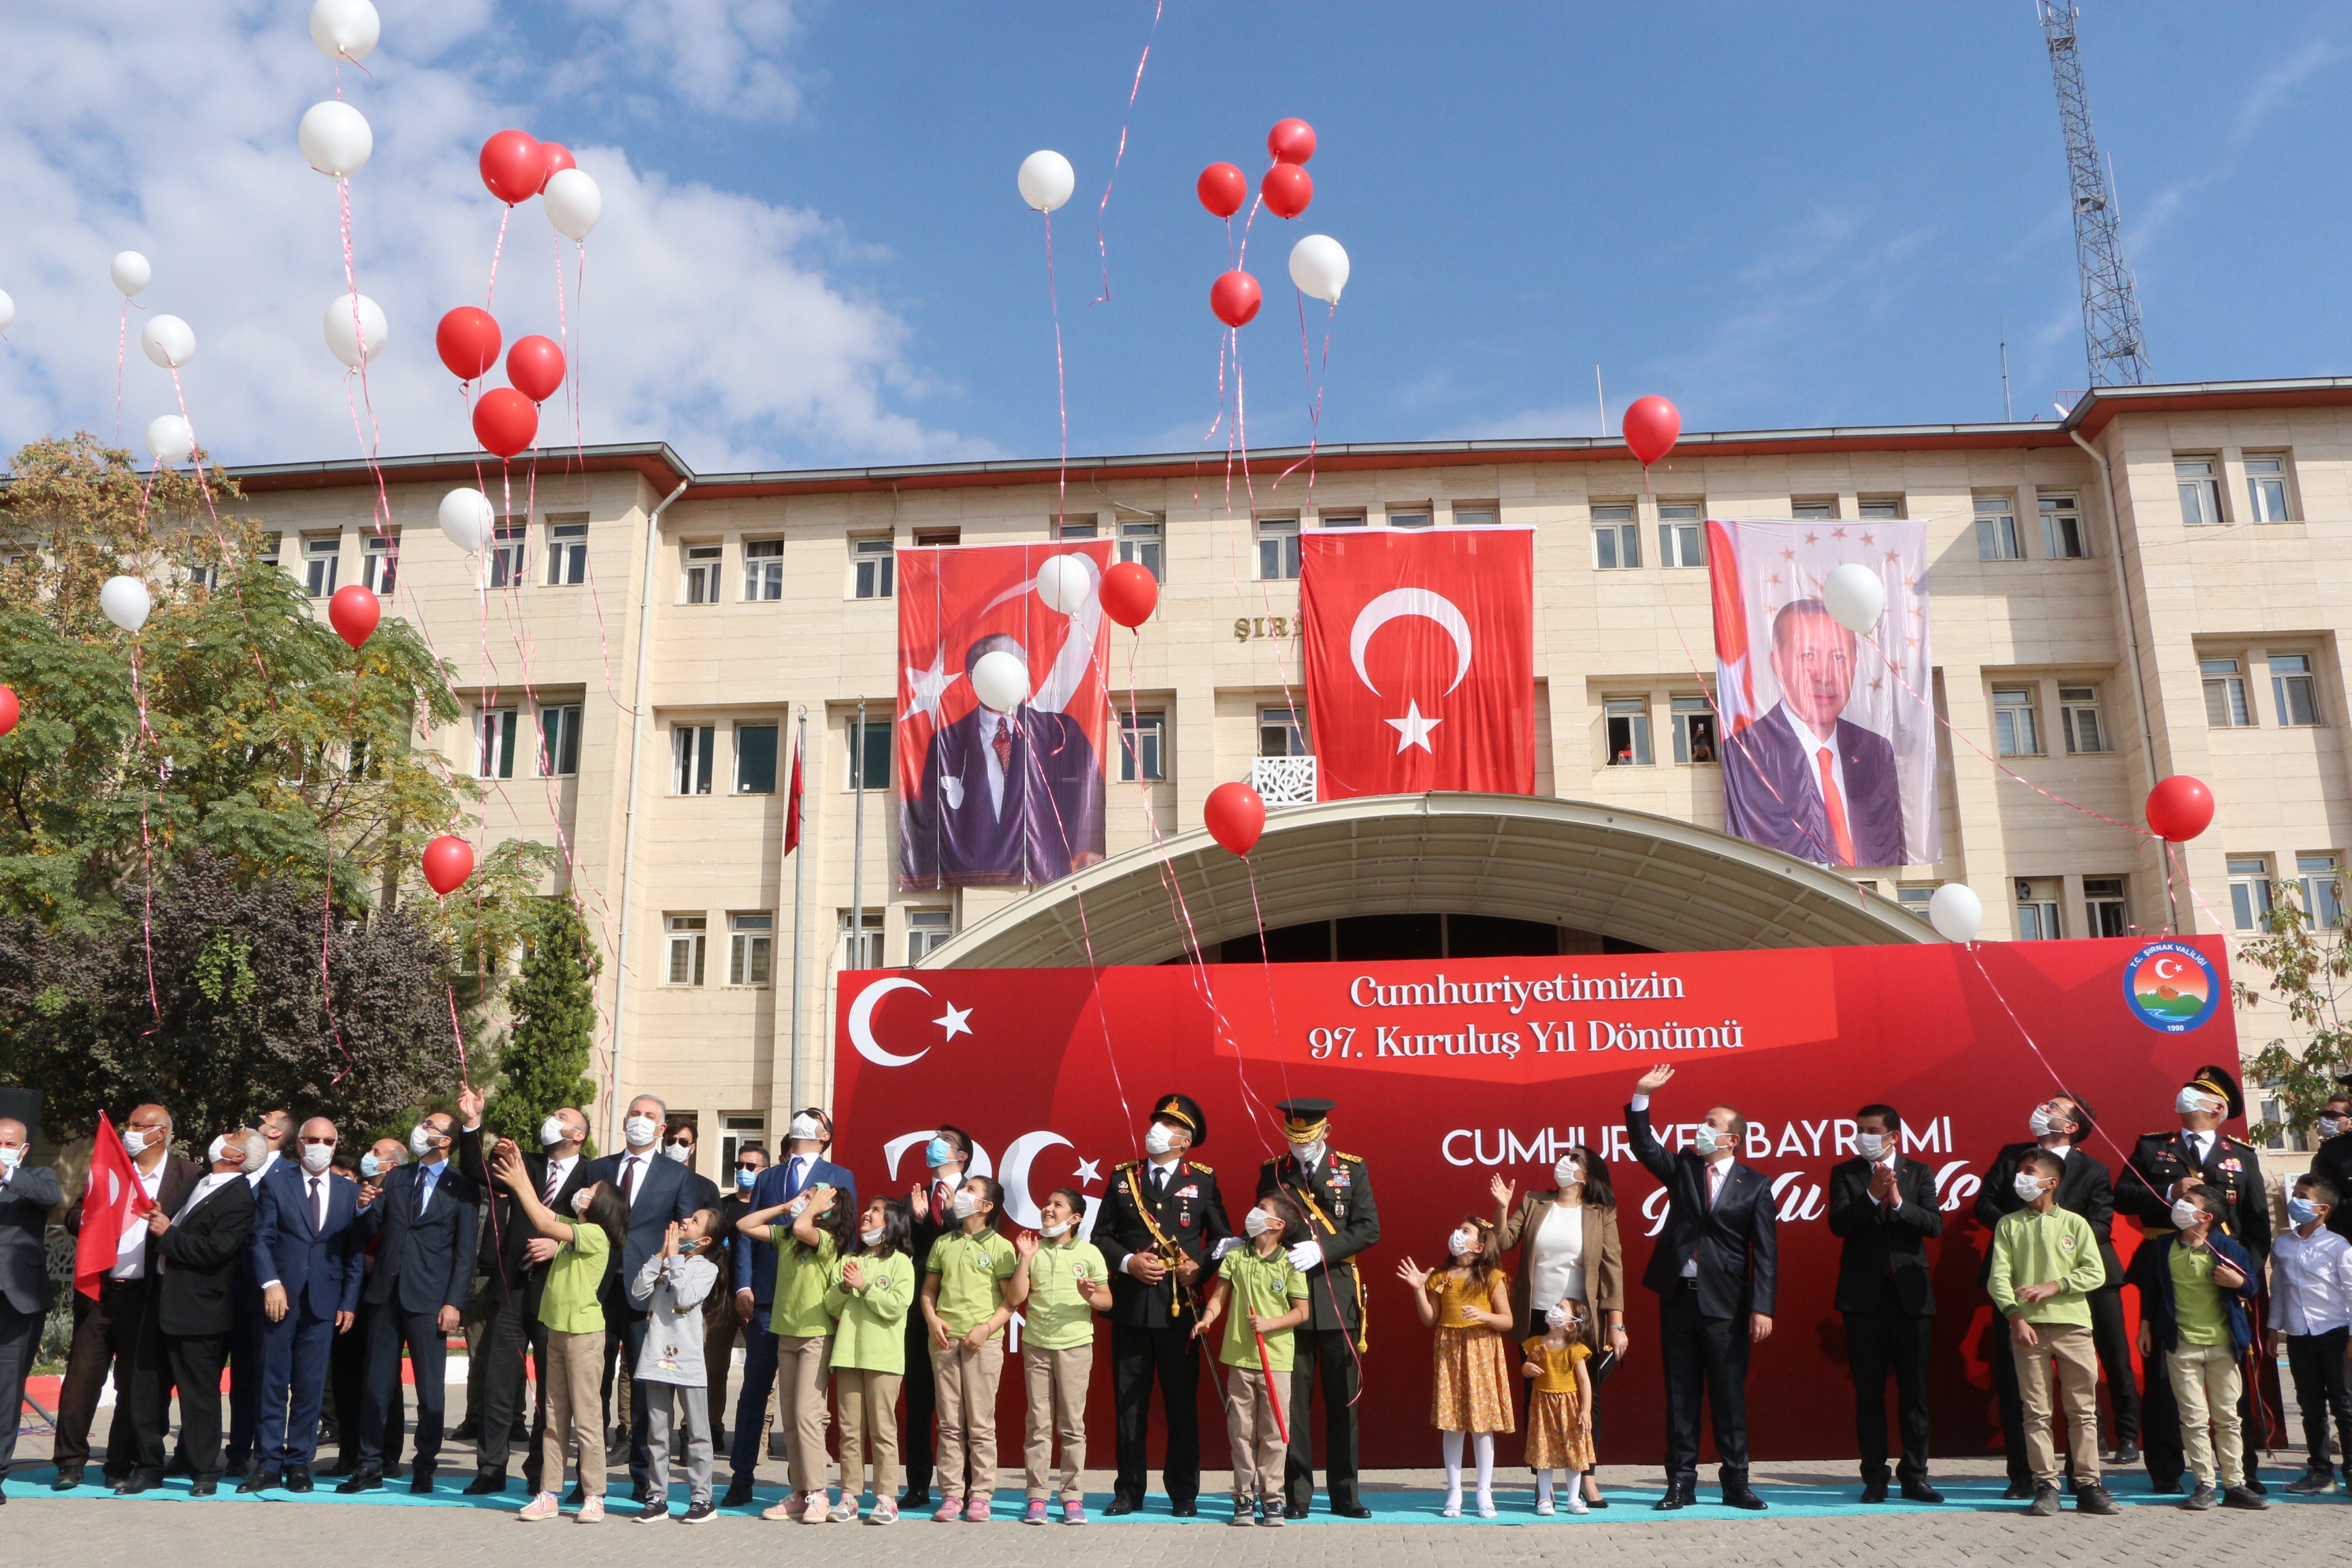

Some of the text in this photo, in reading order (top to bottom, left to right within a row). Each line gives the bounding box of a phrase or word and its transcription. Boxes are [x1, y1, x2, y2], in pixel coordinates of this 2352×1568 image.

[2130, 944, 2208, 968] T.C. ŞIRNAK VALİLİĞİ
[1350, 972, 1686, 1015] Cumhuriyetimizin
[1309, 1019, 1745, 1060] 97. Kuruluş Yıl Dönümü
[1441, 1115, 1953, 1166] CUMHURYE BAYRMI
